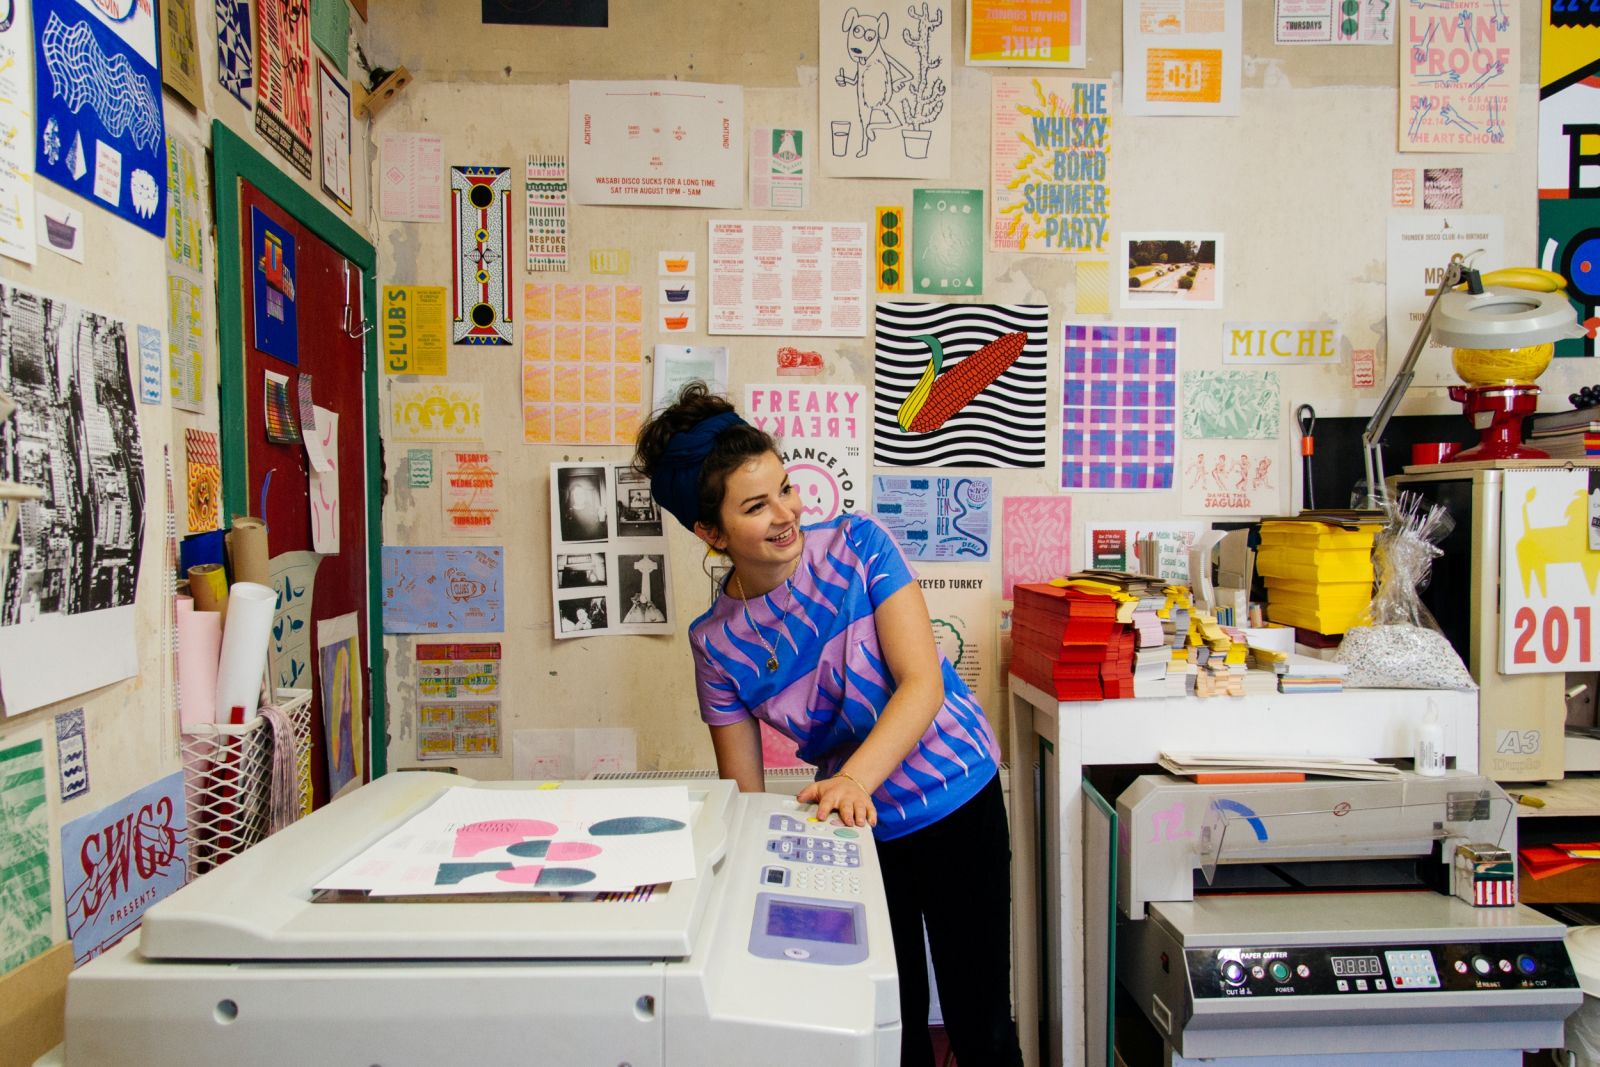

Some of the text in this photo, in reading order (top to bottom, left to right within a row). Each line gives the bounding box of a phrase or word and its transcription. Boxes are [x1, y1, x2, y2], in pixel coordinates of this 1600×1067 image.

[1286, 20, 1322, 30] THURSDAYS
[1001, 35, 1051, 57] BAKE
[1410, 47, 1510, 75] PROOF
[1072, 82, 1107, 114] THE
[722, 118, 730, 149] ACHTUNG!
[1032, 117, 1107, 147] WHISKY
[1432, 132, 1455, 143] ART
[1054, 150, 1106, 181] BOND
[595, 177, 621, 185] WASABI
[683, 178, 699, 187] LONG
[700, 179, 716, 187] TIME
[610, 186, 623, 194] SAT
[624, 187, 639, 195] 17TH
[640, 187, 664, 195] AUGUST
[666, 187, 681, 195] 11PM
[687, 187, 702, 196] 5AM
[1023, 183, 1107, 214] SUMMER
[528, 218, 566, 227] RISOTTO
[1045, 217, 1107, 248] PARTY
[529, 236, 566, 244] BESPOKE
[1401, 233, 1424, 241] THUNDER
[1425, 233, 1441, 241] DISCO
[529, 245, 566, 253] ATELIER
[1230, 329, 1336, 357] MICHE
[751, 390, 859, 413] FREAKY
[455, 453, 490, 463] TUESDAYS
[450, 479, 494, 488] WEDNESDAYS
[837, 468, 853, 491] TO
[1204, 499, 1250, 508] JAGUAR
[453, 516, 492, 526] THURSDAYS
[949, 580, 983, 589] TURKEY
[1514, 606, 1591, 665] 201
[1497, 729, 1540, 755] A3
[110, 887, 156, 924] PRESENTS
